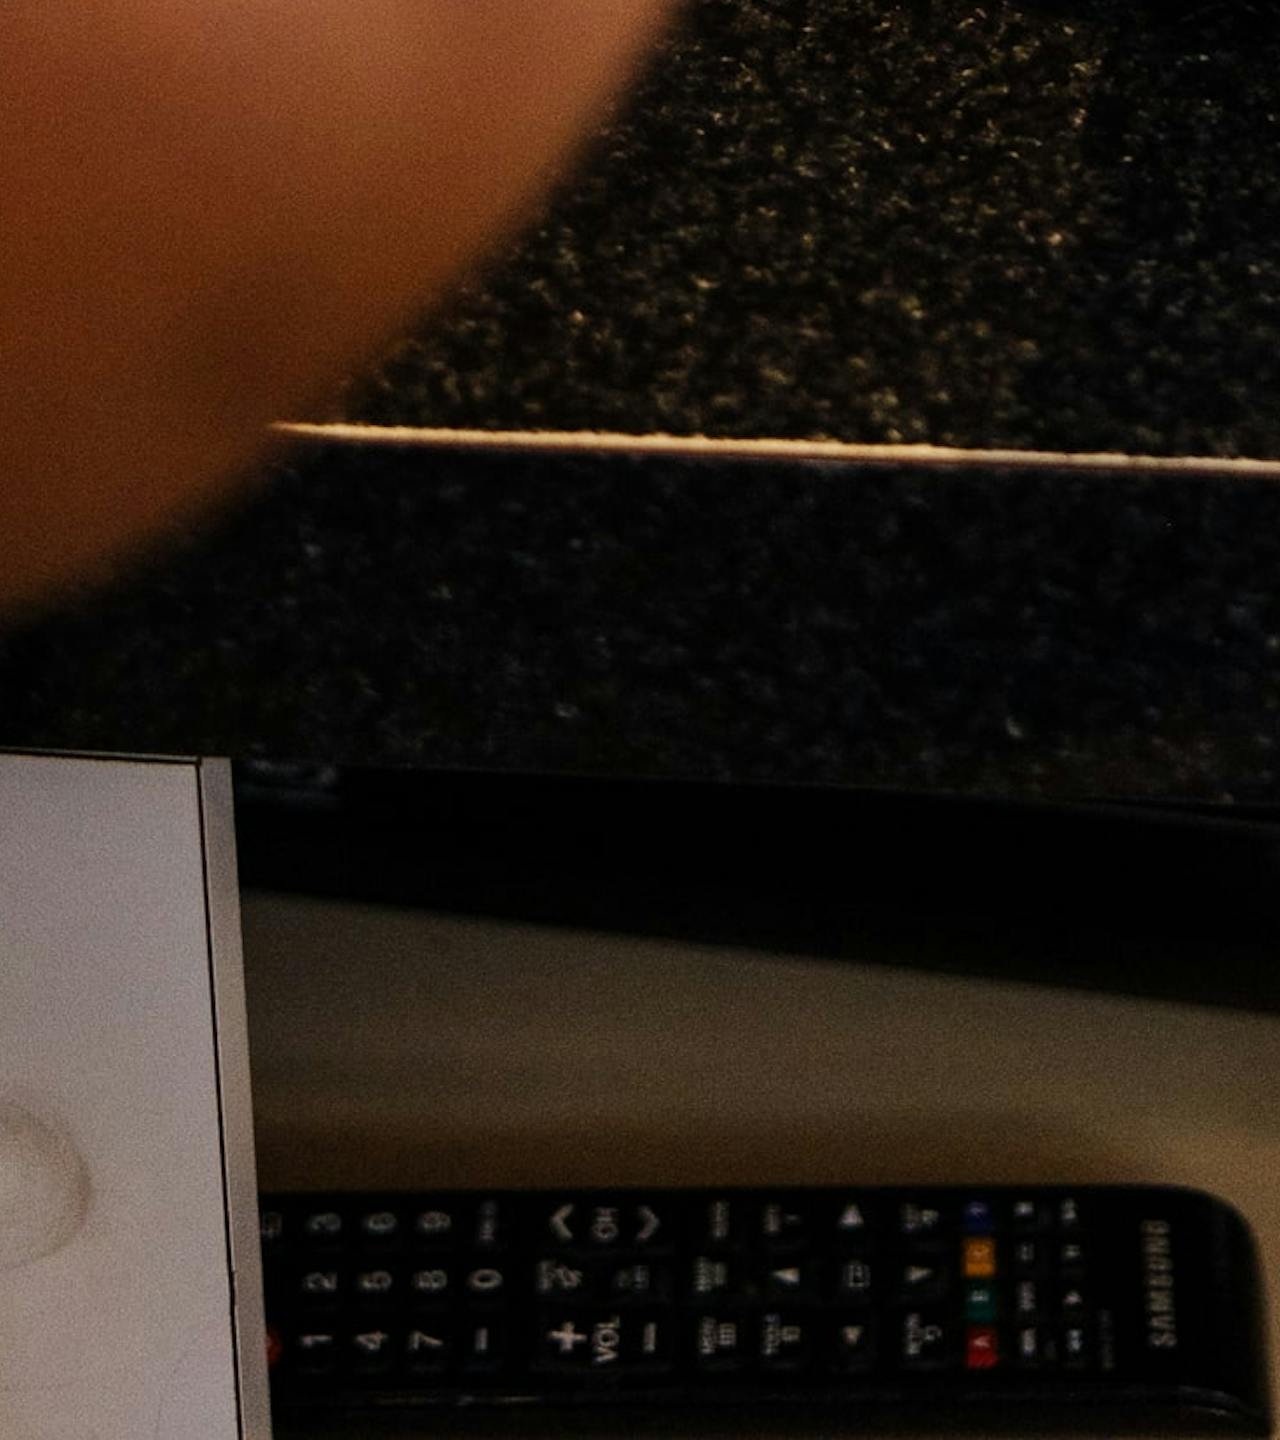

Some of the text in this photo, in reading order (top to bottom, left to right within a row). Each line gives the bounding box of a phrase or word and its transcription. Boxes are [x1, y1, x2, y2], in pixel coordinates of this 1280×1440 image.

[468, 1268, 503, 1290] 0
[1139, 1218, 1178, 1349] SAMSUNG
[301, 1333, 333, 1348] 1
[355, 1330, 389, 1351] 4
[408, 1330, 444, 1351] 7
[592, 1316, 620, 1365] VOL
